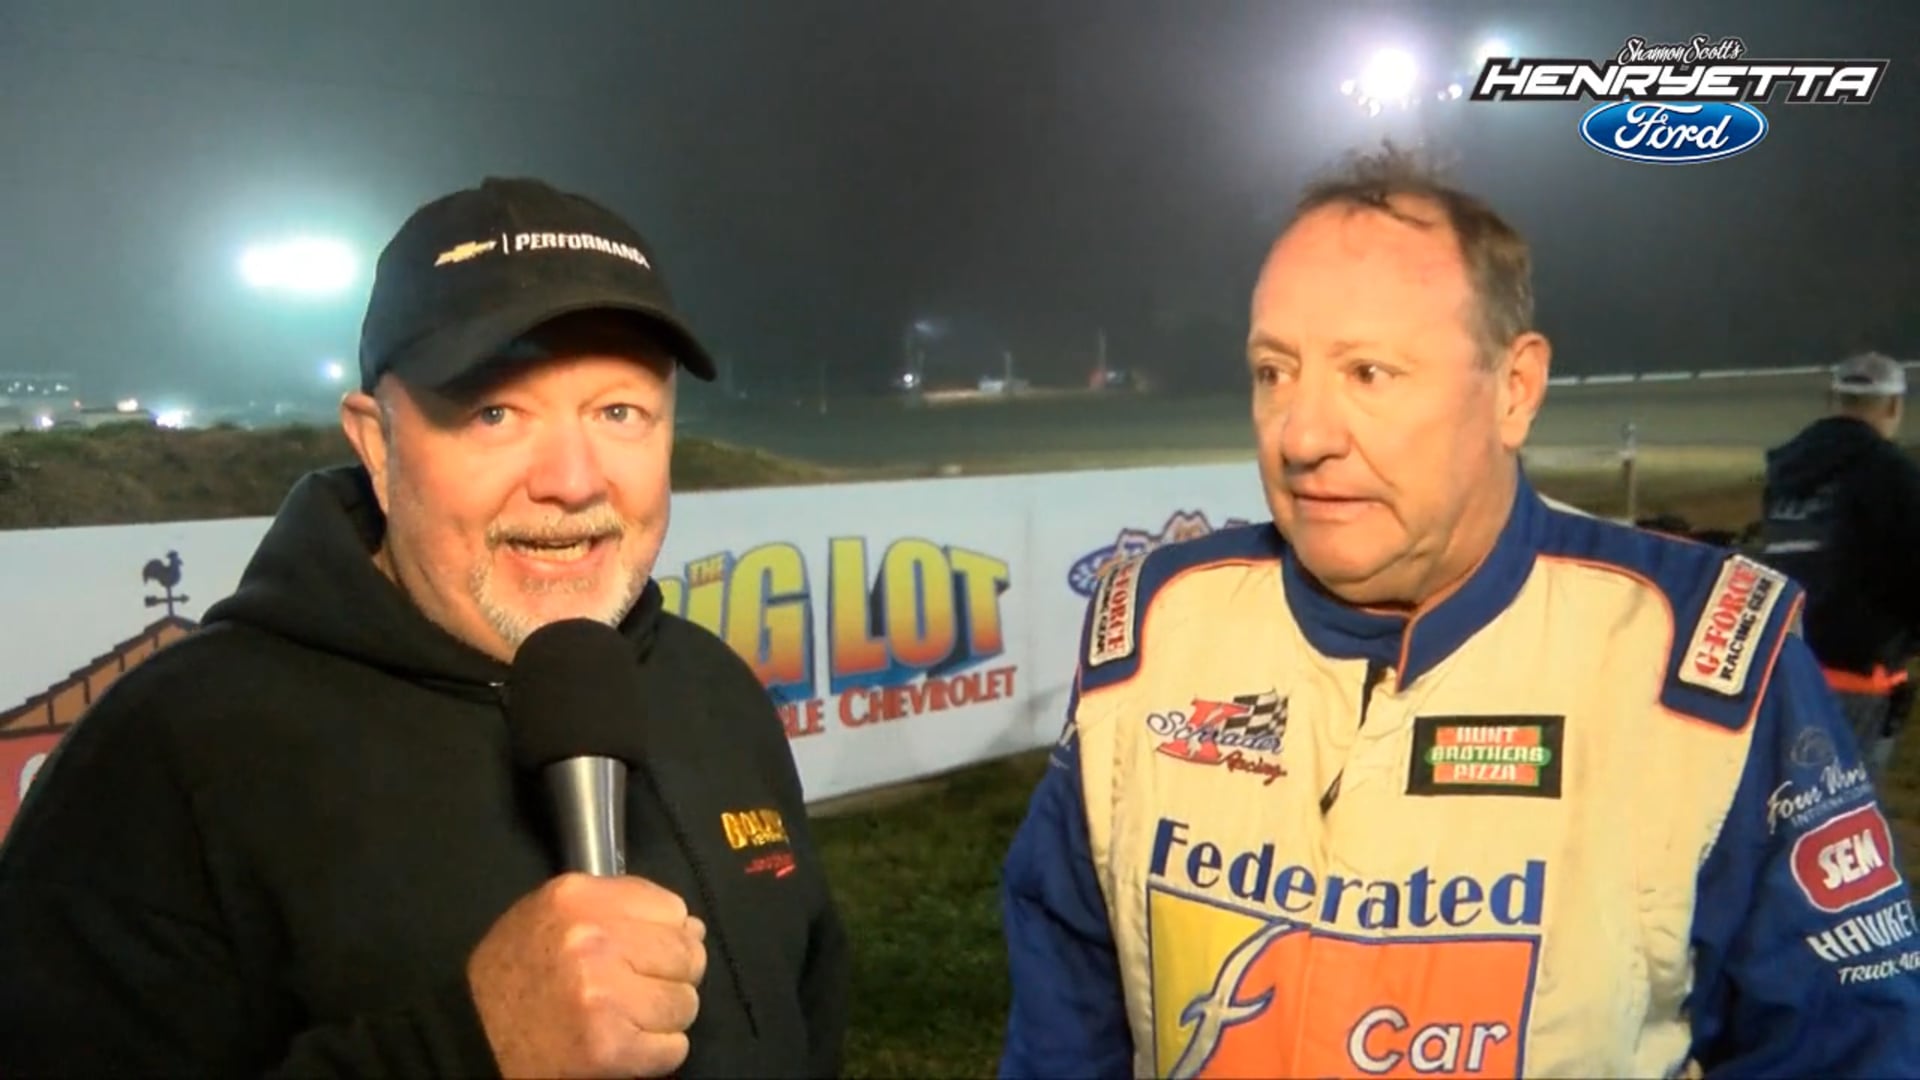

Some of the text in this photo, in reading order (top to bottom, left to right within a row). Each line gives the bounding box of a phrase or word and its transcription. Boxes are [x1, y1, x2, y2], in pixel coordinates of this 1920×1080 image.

[828, 536, 1010, 690] LOT
[1694, 563, 1757, 676] G-FORCE
[1719, 611, 1757, 682] RACING
[776, 666, 1018, 741] LE CHEVROLET
[1456, 726, 1518, 744] HUNT
[1221, 749, 1288, 787] Racing
[1431, 745, 1546, 763] BROTHERS
[1453, 763, 1518, 782] PIZZA
[1149, 817, 1547, 930] Federated
[1817, 828, 1884, 891] SEM
[1837, 959, 1901, 986] TRUCK
[1347, 1004, 1511, 1074] Car
